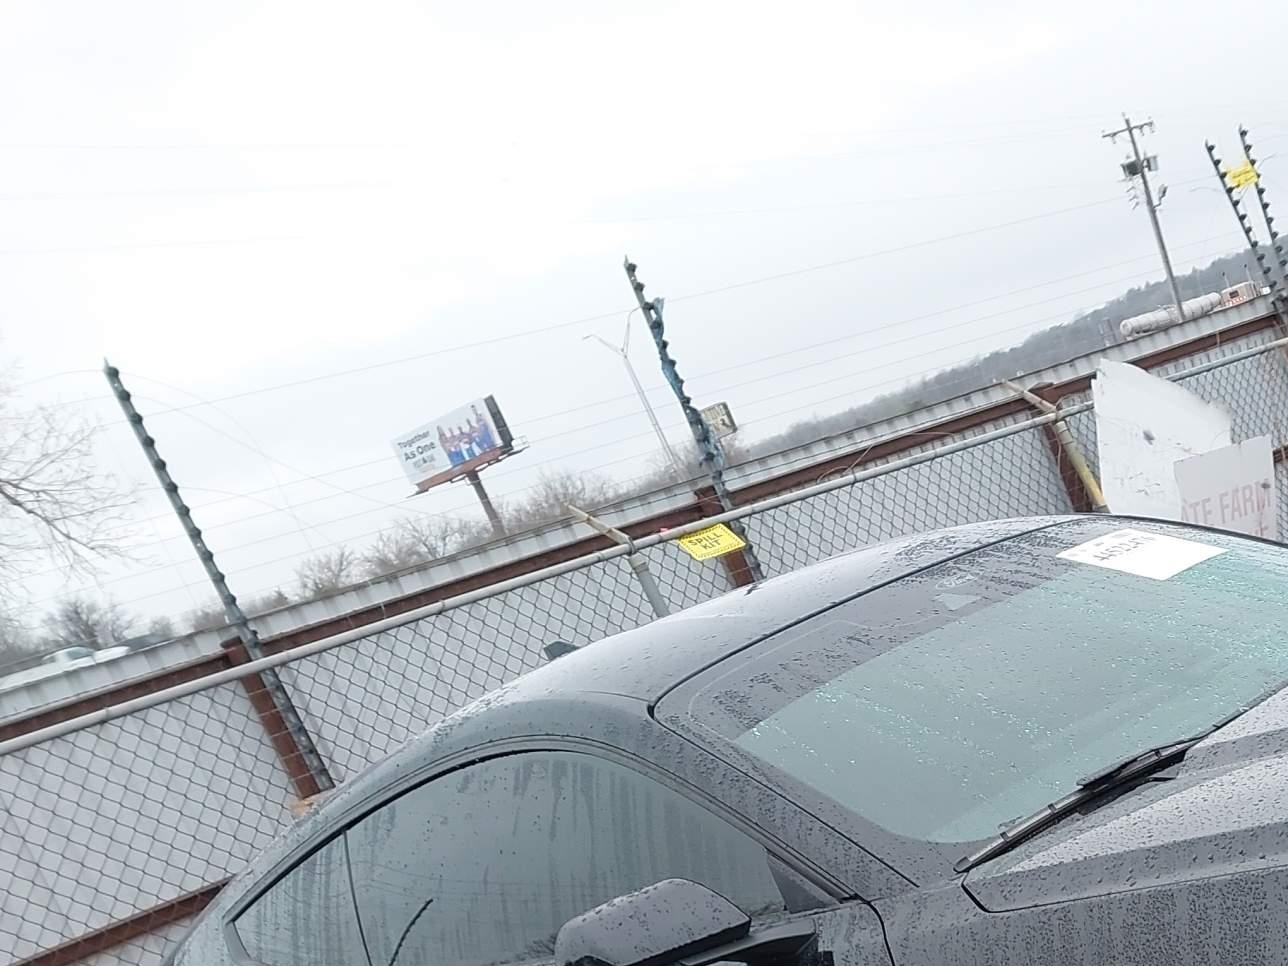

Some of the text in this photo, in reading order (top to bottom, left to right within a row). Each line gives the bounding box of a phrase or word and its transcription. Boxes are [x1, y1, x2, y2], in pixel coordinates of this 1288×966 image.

[403, 441, 436, 462] As One
[1218, 481, 1272, 525] FARM
[687, 532, 723, 546] SPILL
[700, 539, 722, 551] KIT
